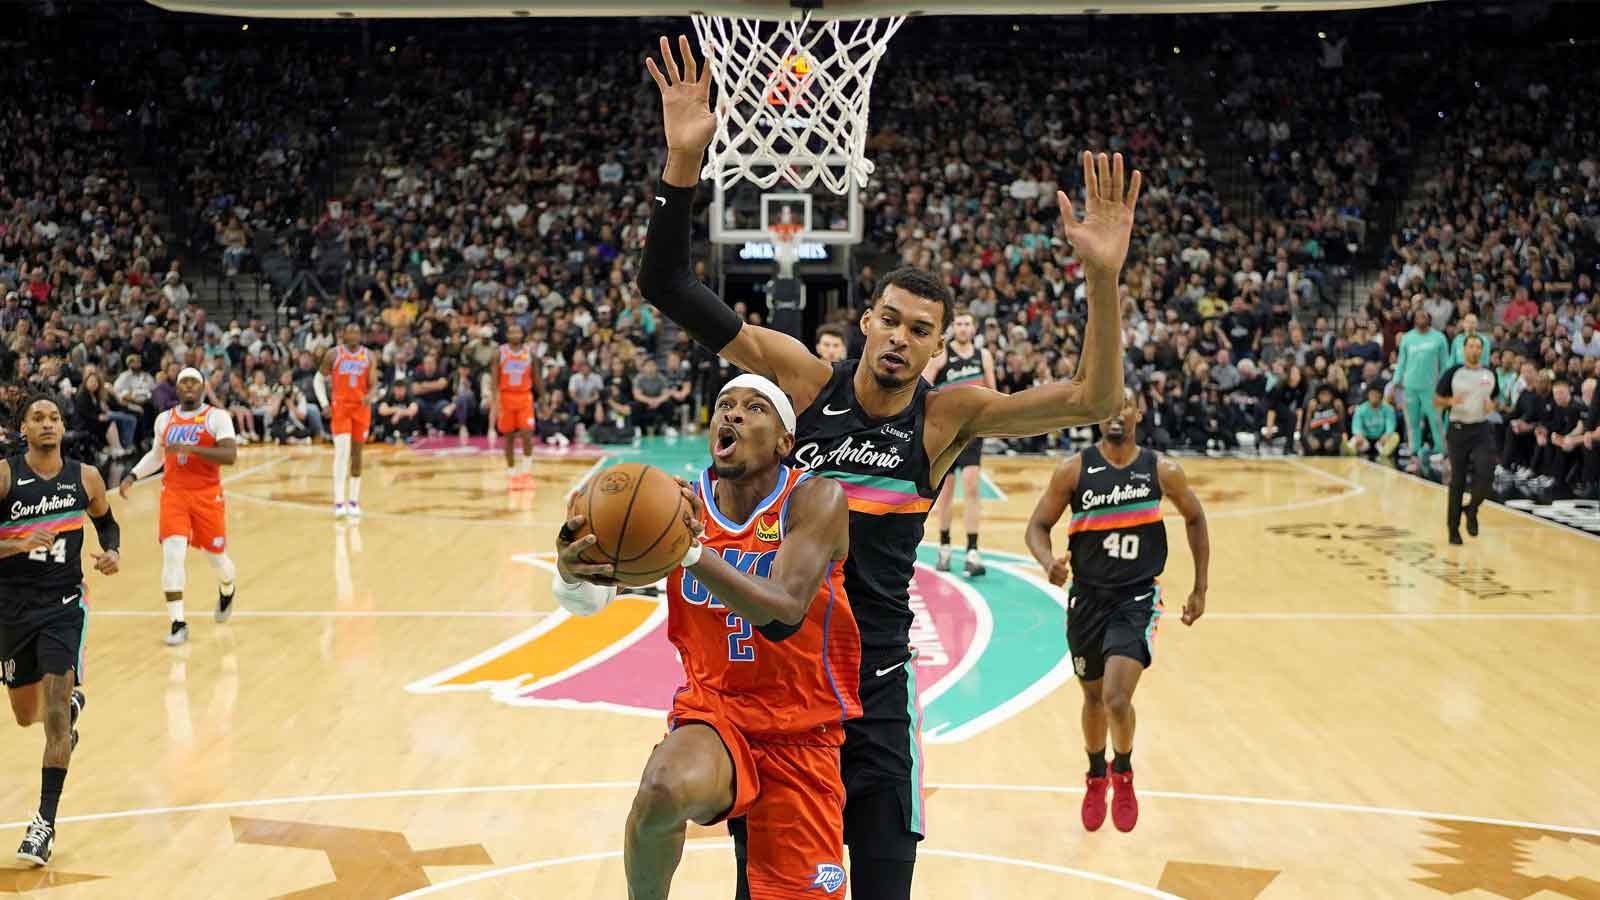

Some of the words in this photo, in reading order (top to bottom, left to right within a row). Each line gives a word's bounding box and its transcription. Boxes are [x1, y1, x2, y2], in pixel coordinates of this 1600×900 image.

[167, 424, 205, 446] OKC
[884, 424, 911, 441] LEDGER
[793, 441, 827, 472] Sa
[827, 436, 904, 469] Antonio
[11, 500, 34, 520] San
[34, 494, 76, 514] Antonio
[1082, 489, 1105, 510] San
[1105, 484, 1151, 505] Antonio
[28, 538, 66, 563] 24
[1103, 532, 1140, 560] 40
[726, 611, 755, 662] 2
